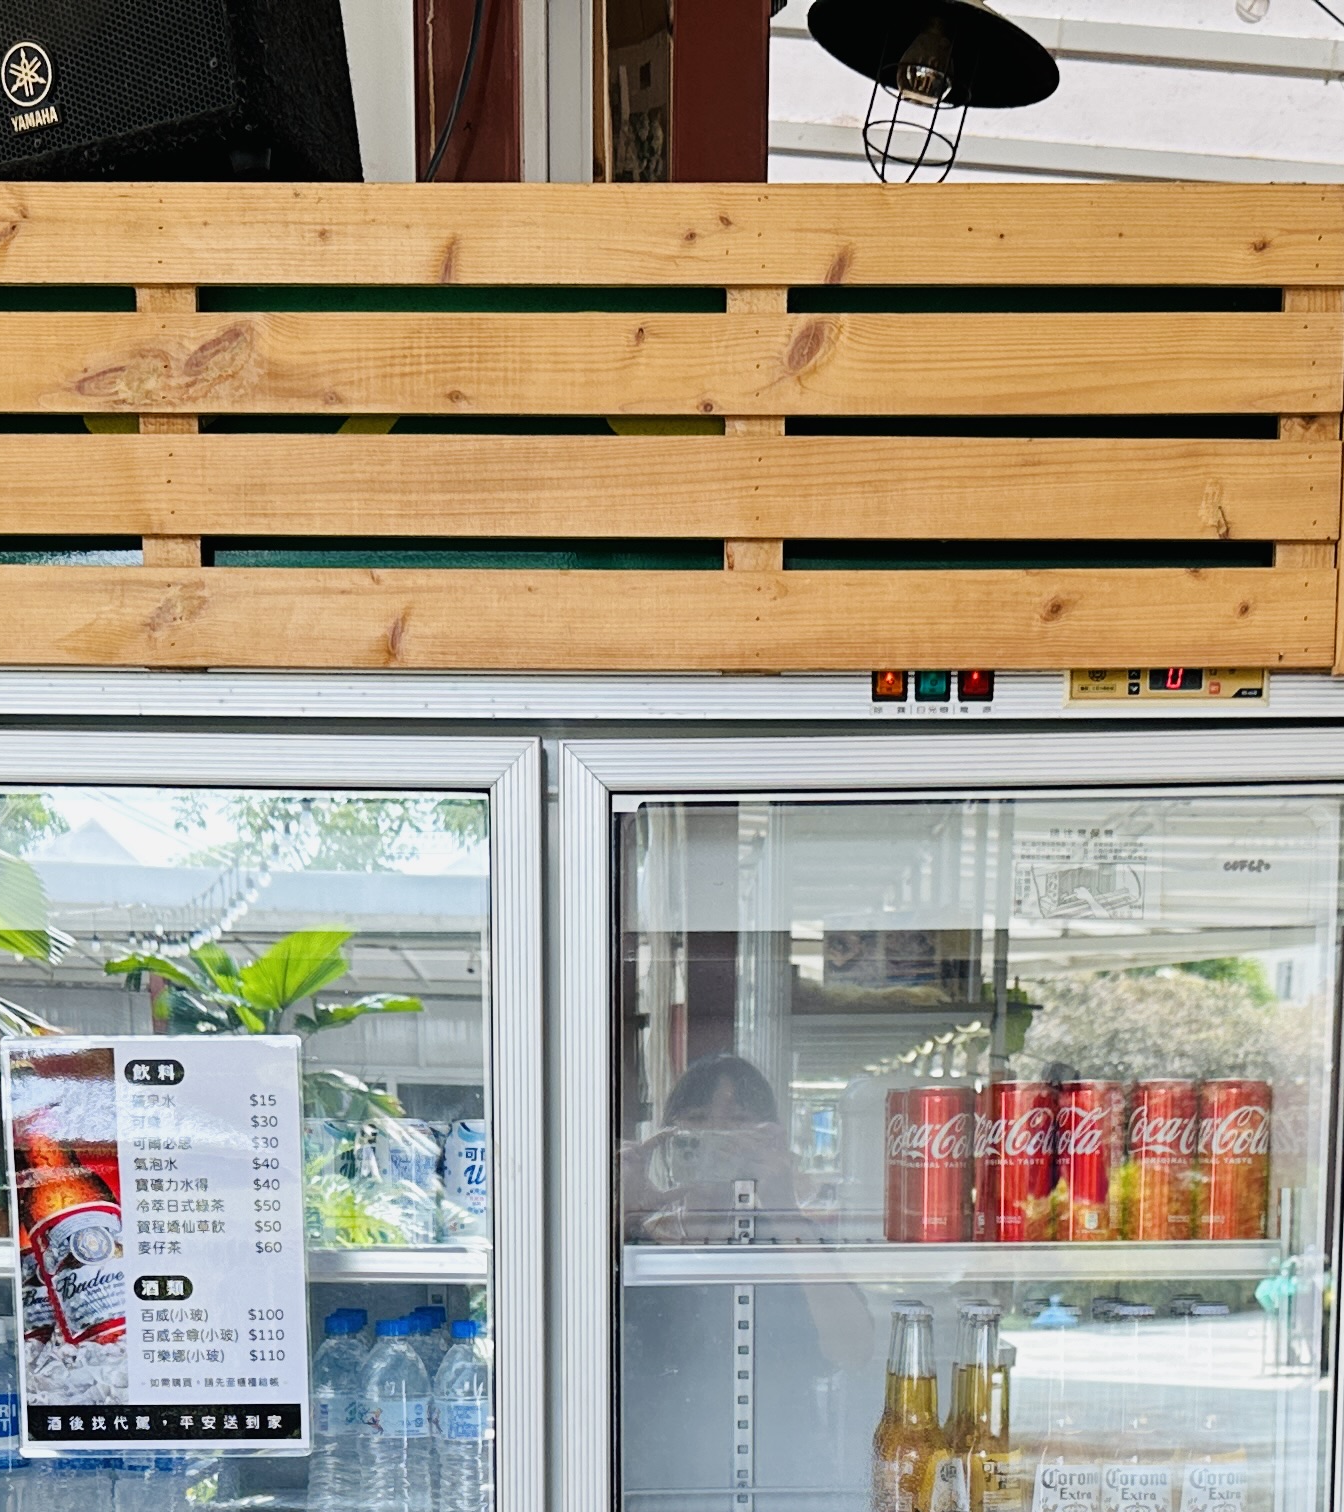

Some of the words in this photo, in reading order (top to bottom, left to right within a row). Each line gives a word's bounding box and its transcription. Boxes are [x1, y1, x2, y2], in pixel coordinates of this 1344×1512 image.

[10, 106, 59, 132] YAMAHA
[132, 1065, 175, 1081] 飲料
[250, 1094, 277, 1107] $15
[251, 1115, 278, 1128] $30
[133, 1137, 192, 1150] 可爾必思
[251, 1137, 279, 1149] $30
[134, 1157, 178, 1171] 氣泡水
[253, 1158, 280, 1171] $40
[135, 1178, 208, 1192] 寶礦力水得
[253, 1179, 280, 1192] $40
[137, 1199, 224, 1213] 冷萃日式綠茶
[254, 1199, 281, 1212] $50
[254, 1220, 282, 1233] $50
[138, 1241, 182, 1255] 麥仔茶
[255, 1241, 282, 1254] $60
[141, 1280, 185, 1296] 酒類
[141, 1308, 208, 1323] 百威(小玻)
[248, 1308, 284, 1321] $100
[141, 1328, 239, 1343] 百威金尊(小玻)
[249, 1328, 285, 1341] $110
[142, 1349, 225, 1363] 可樂娜(小玻)
[249, 1349, 285, 1361] $110
[1106, 1468, 1168, 1491] Corona
